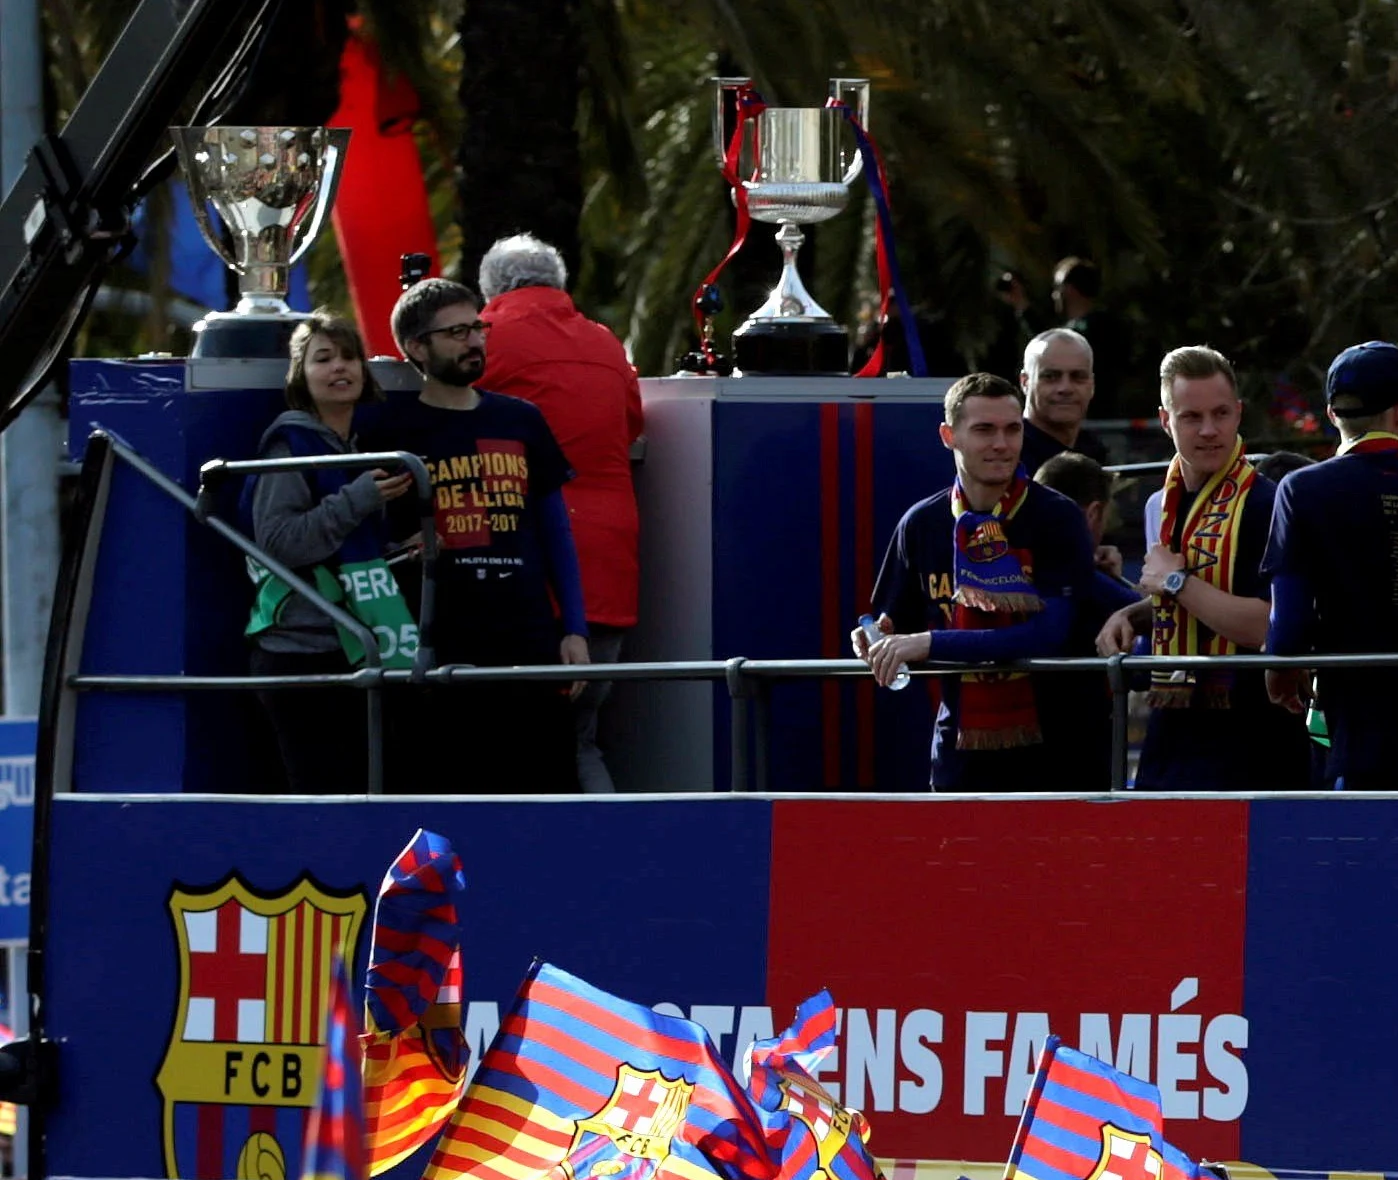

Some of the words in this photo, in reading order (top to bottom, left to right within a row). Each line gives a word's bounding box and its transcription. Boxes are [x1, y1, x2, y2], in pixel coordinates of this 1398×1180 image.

[426, 452, 529, 485] CAMPIONS
[436, 484, 466, 509] DE
[446, 513, 519, 533] 2017-201
[224, 1051, 303, 1099] FCB
[963, 1010, 1050, 1117] FA
